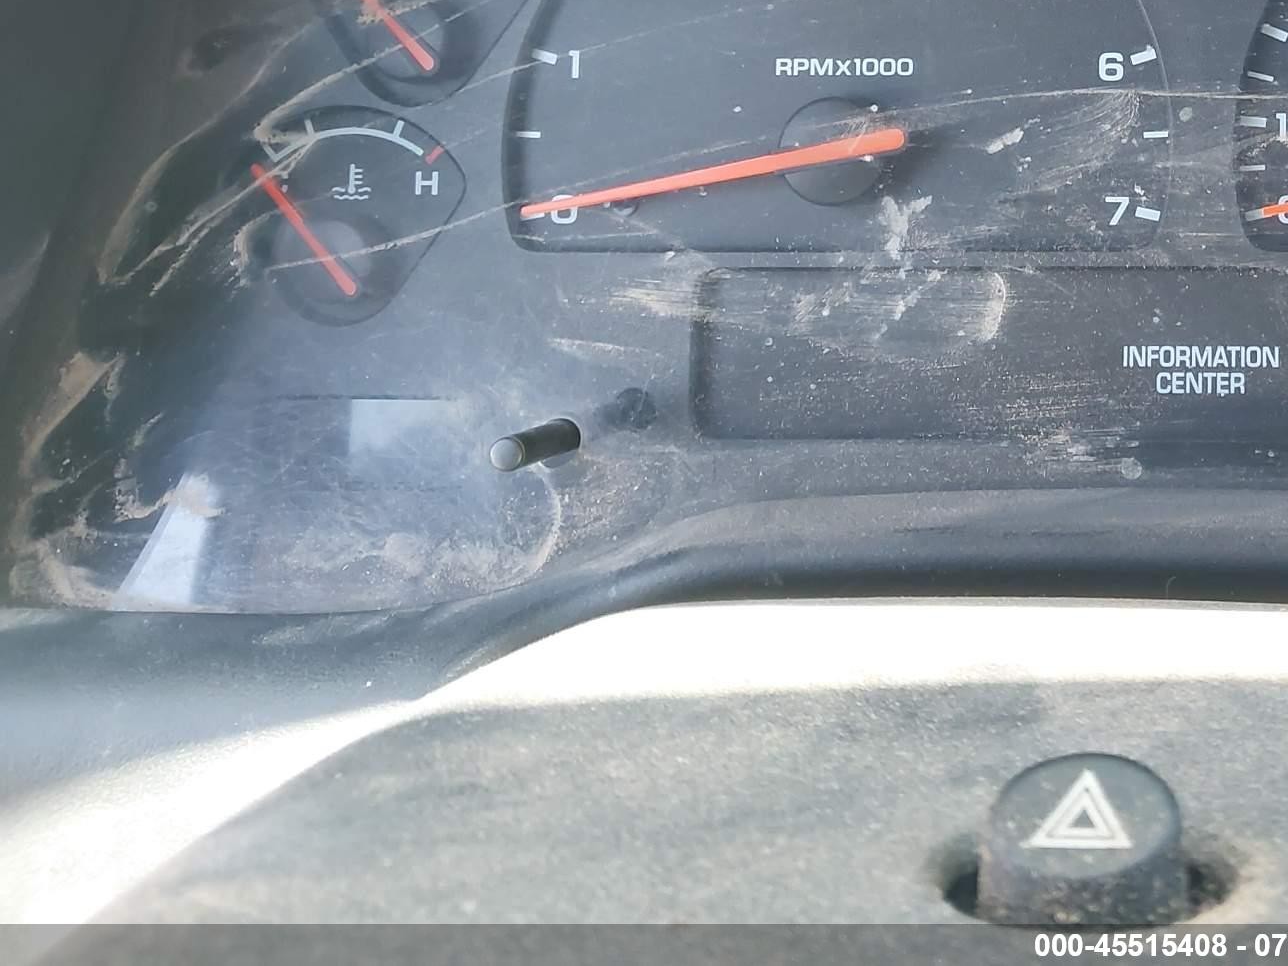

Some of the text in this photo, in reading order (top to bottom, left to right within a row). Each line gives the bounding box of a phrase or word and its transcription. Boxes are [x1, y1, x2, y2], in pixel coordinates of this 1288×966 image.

[568, 50, 581, 78] 1
[1098, 52, 1124, 82] 6
[415, 171, 439, 195] H
[551, 194, 578, 224] 0
[1104, 198, 1131, 225] 7
[1123, 345, 1280, 368] INFORMATION
[1156, 372, 1245, 394] CENTER
